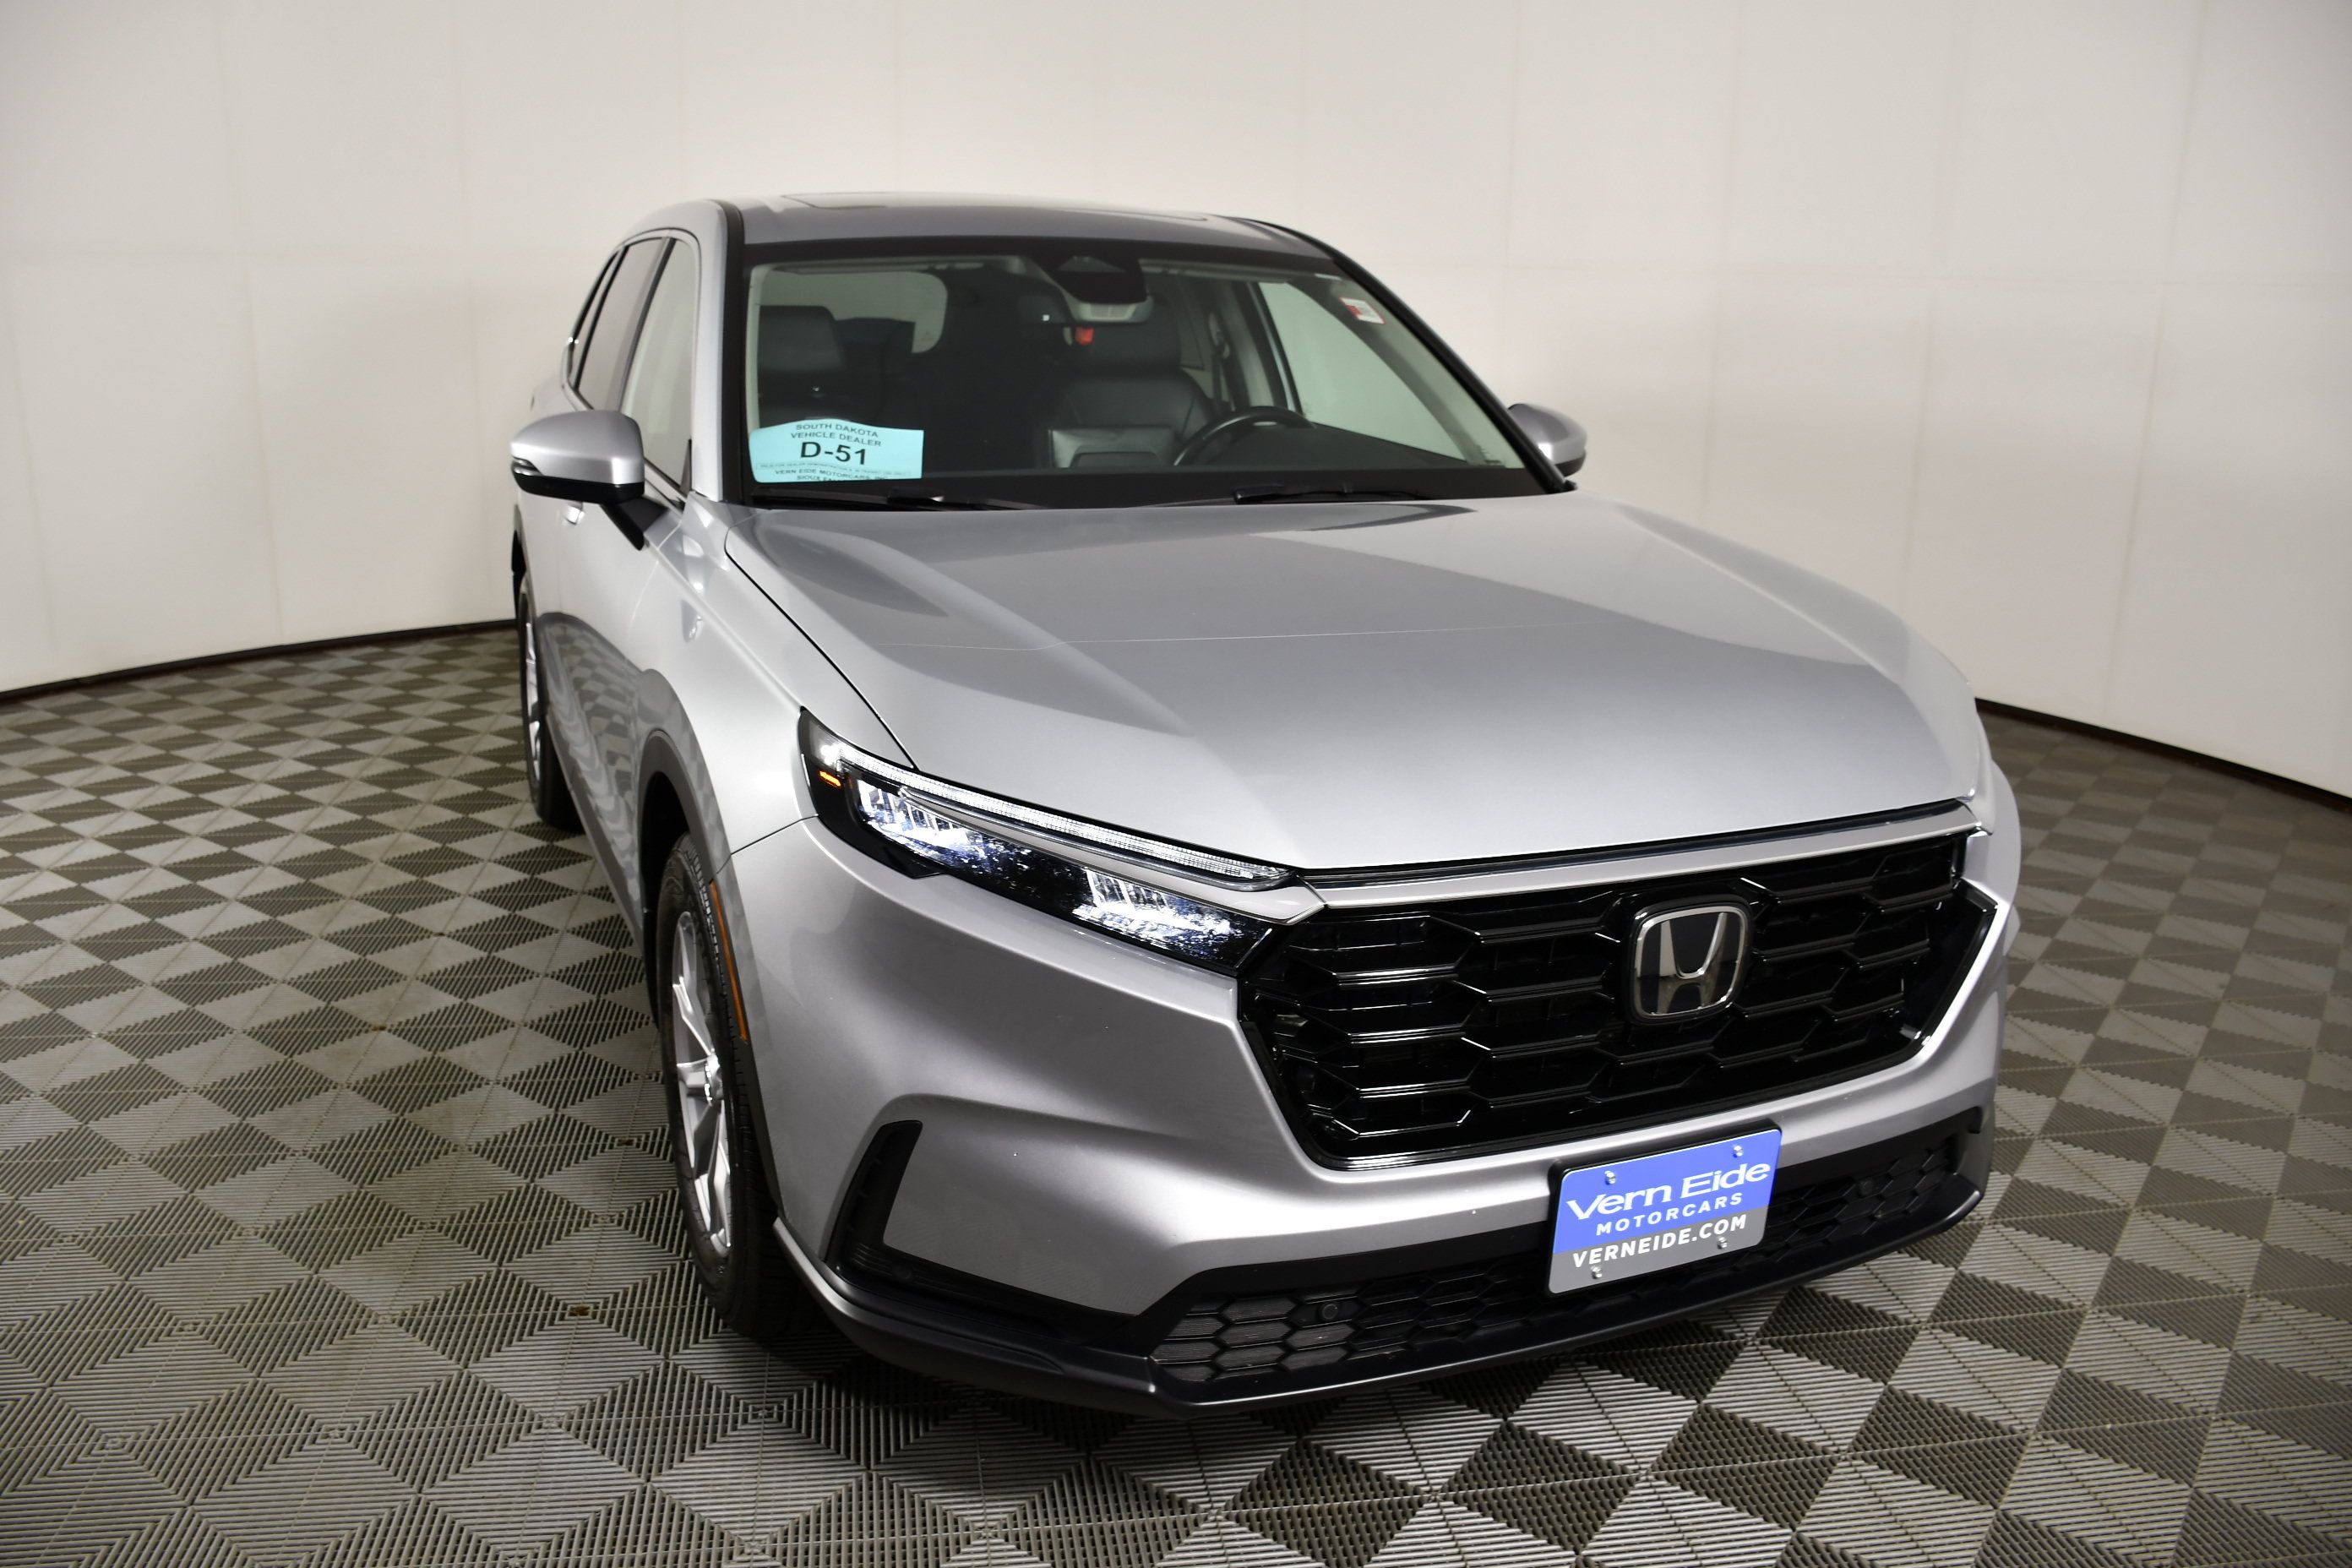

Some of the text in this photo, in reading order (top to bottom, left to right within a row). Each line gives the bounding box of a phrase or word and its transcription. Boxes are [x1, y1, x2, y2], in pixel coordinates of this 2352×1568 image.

[836, 424, 879, 438] DAKOTA
[839, 434, 882, 447] DEALER
[800, 441, 866, 466] D-51
[1566, 1162, 1771, 1220] Vern Eide
[1596, 1192, 1743, 1236] MOTORCARS
[1572, 1214, 1747, 1268] VERNEIDE.COM
